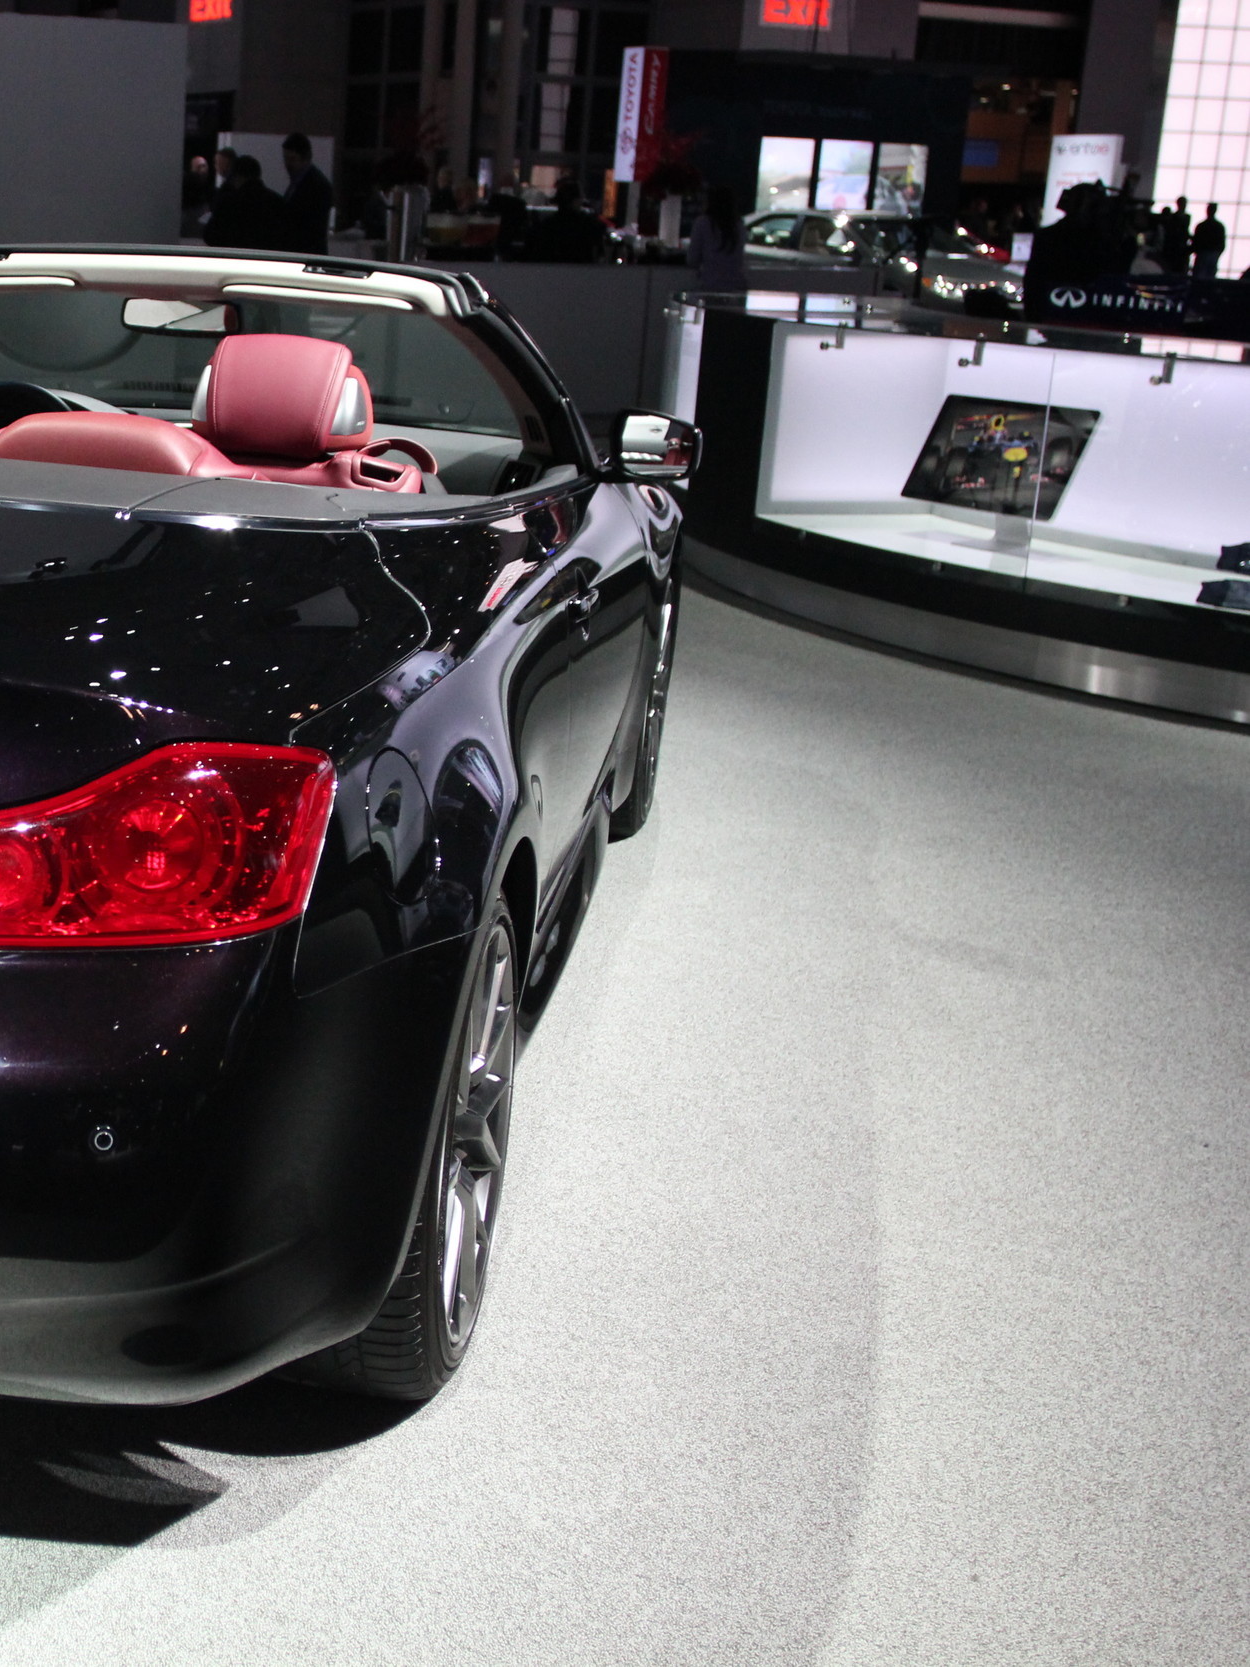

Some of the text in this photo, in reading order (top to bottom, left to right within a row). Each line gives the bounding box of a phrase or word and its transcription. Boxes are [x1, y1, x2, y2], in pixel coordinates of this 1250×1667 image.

[763, 0, 830, 27] EXIT
[624, 52, 639, 121] TOYOTA
[644, 52, 661, 135] CAMRY
[1092, 292, 1184, 313] INFINITI
